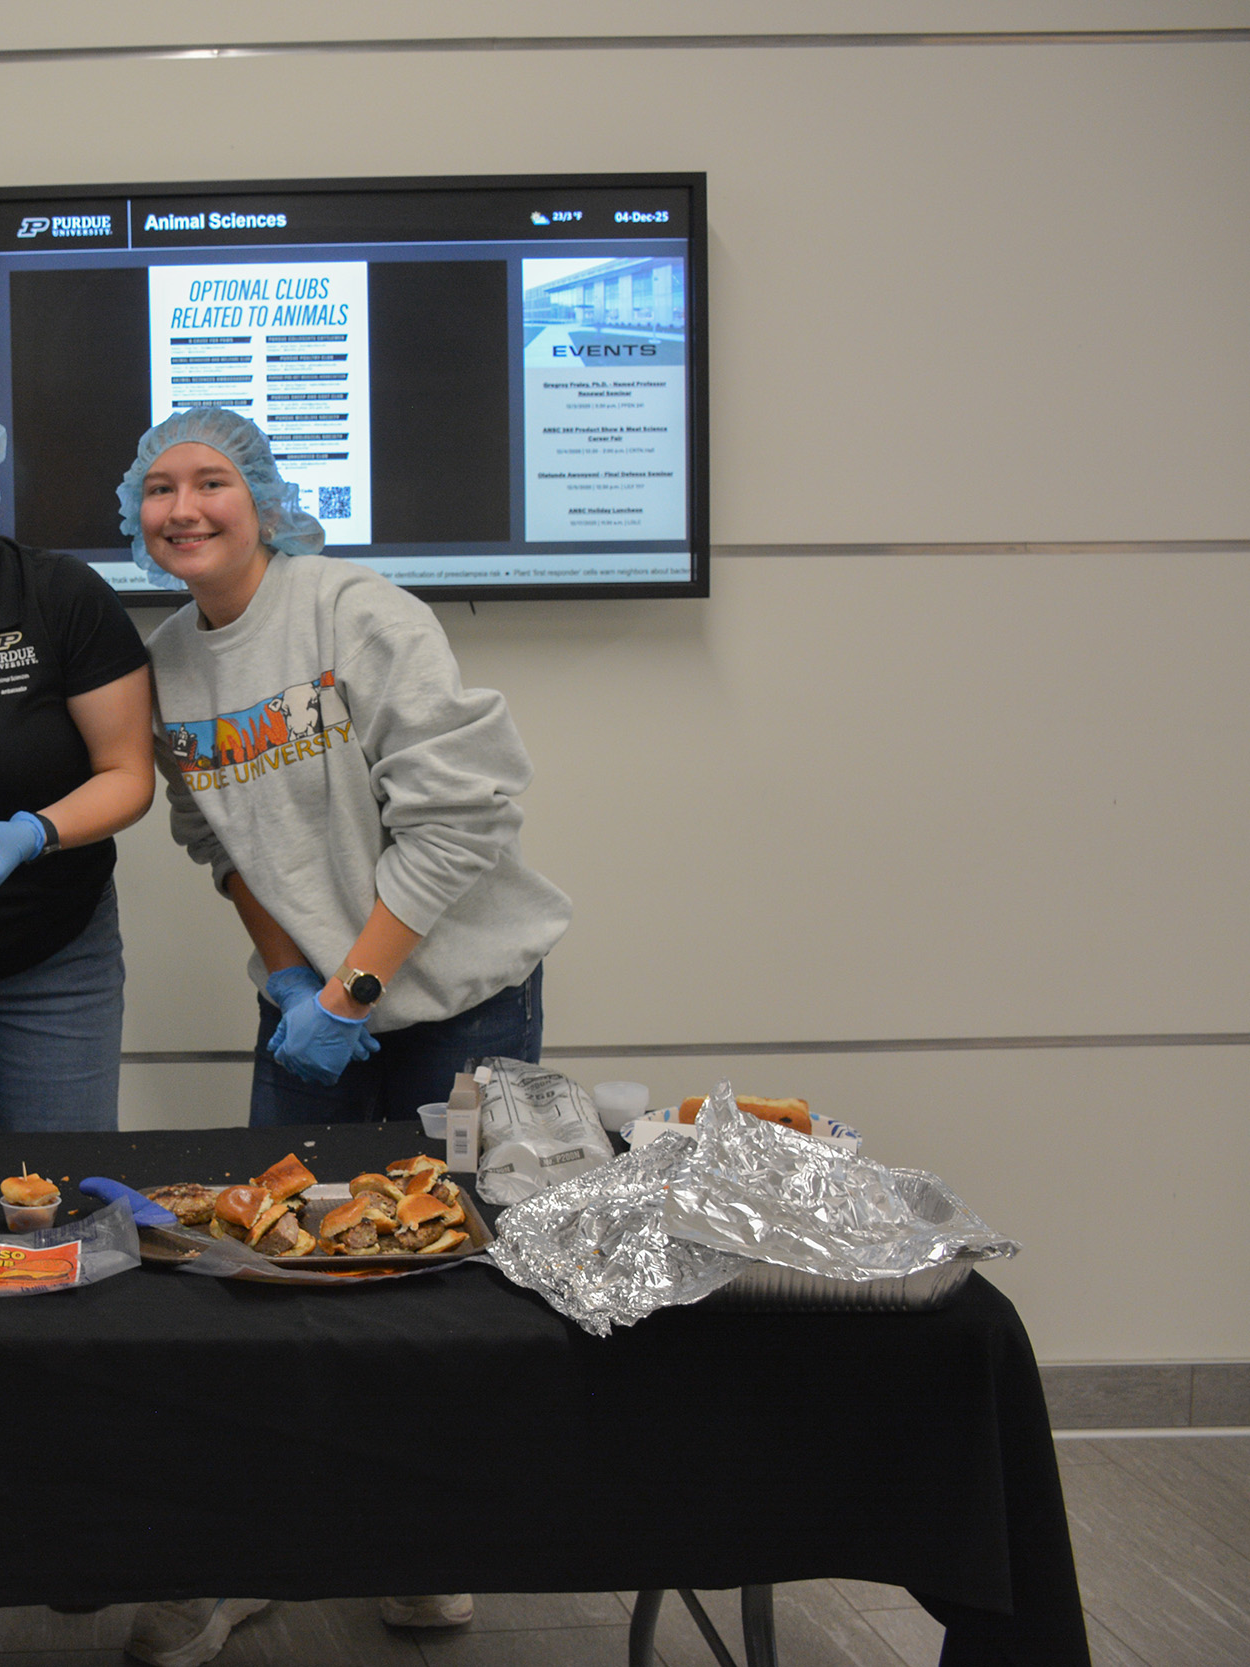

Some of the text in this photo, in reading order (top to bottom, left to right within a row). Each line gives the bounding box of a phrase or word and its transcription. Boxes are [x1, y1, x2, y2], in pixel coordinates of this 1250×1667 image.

[52, 215, 111, 229] PURDUE
[144, 212, 287, 231] Animal Sciences
[614, 210, 669, 223] 04-Dec-25
[189, 277, 329, 302] OPTIONAL CLUBS
[170, 303, 349, 329] RELATED TO ANIMALS
[552, 343, 658, 359] EVENTS
